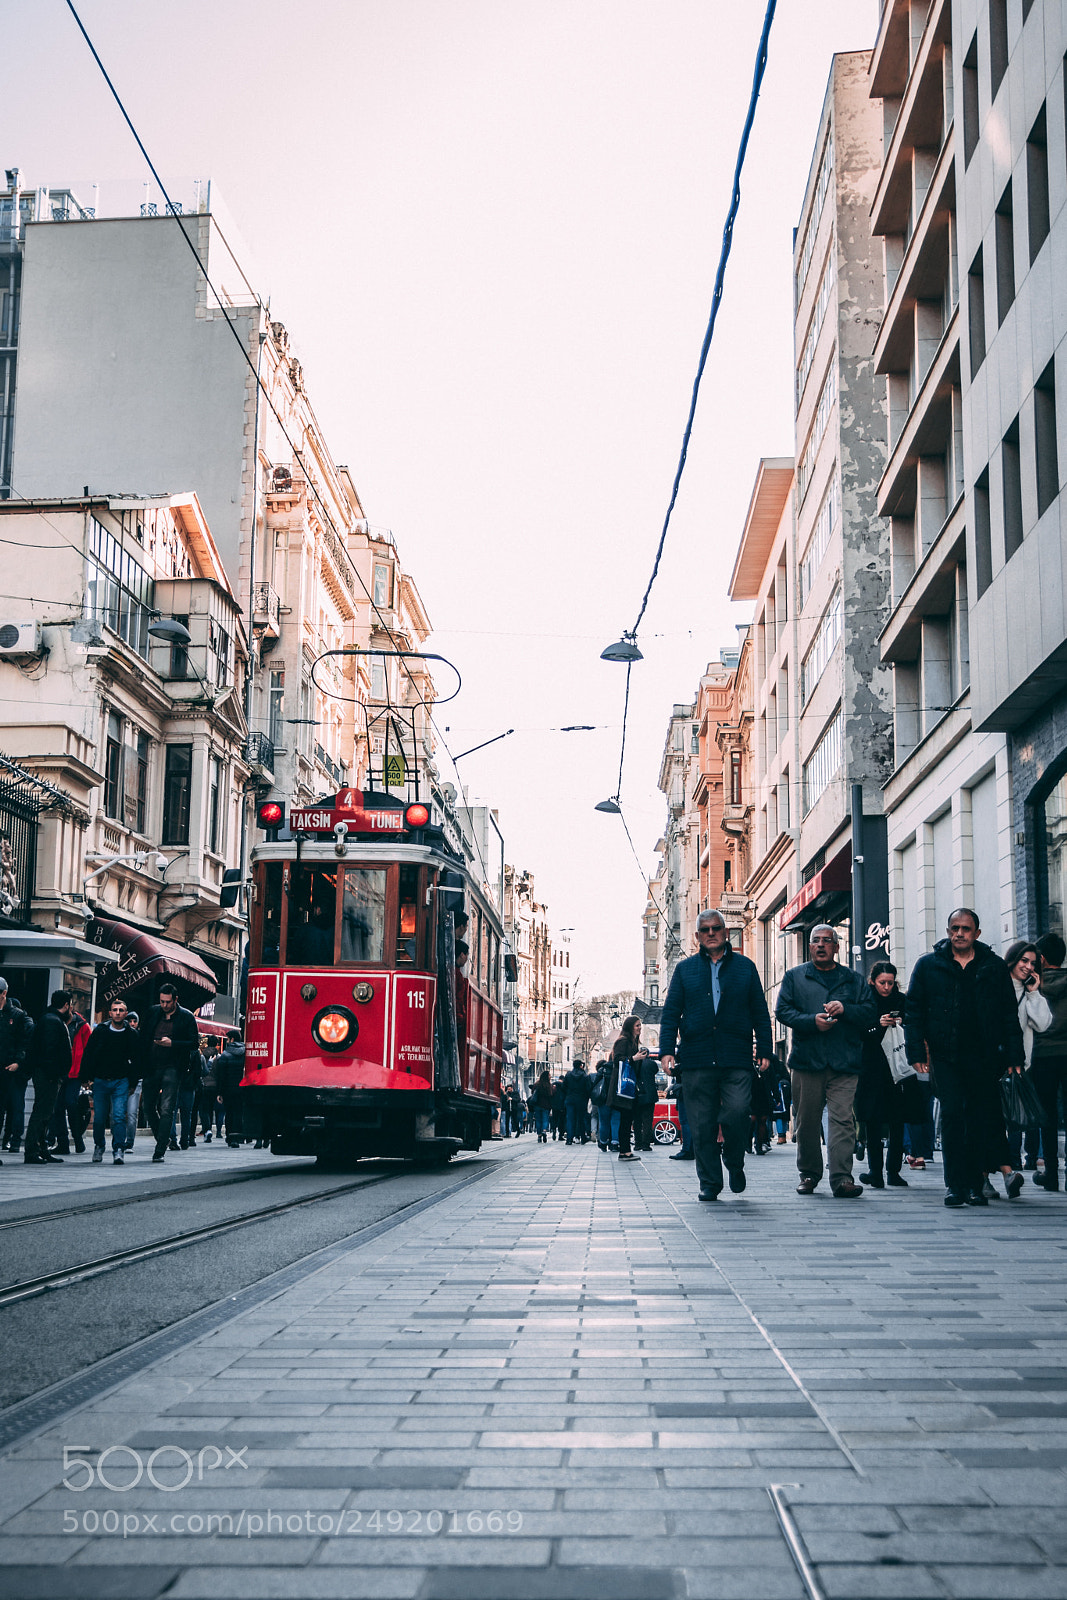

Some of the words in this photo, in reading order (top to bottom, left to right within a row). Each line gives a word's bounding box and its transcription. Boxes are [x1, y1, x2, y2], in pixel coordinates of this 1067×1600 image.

[343, 791, 353, 808] 4
[290, 811, 331, 828] TAKSİM
[251, 986, 267, 1005] 115
[406, 990, 425, 1009] 115
